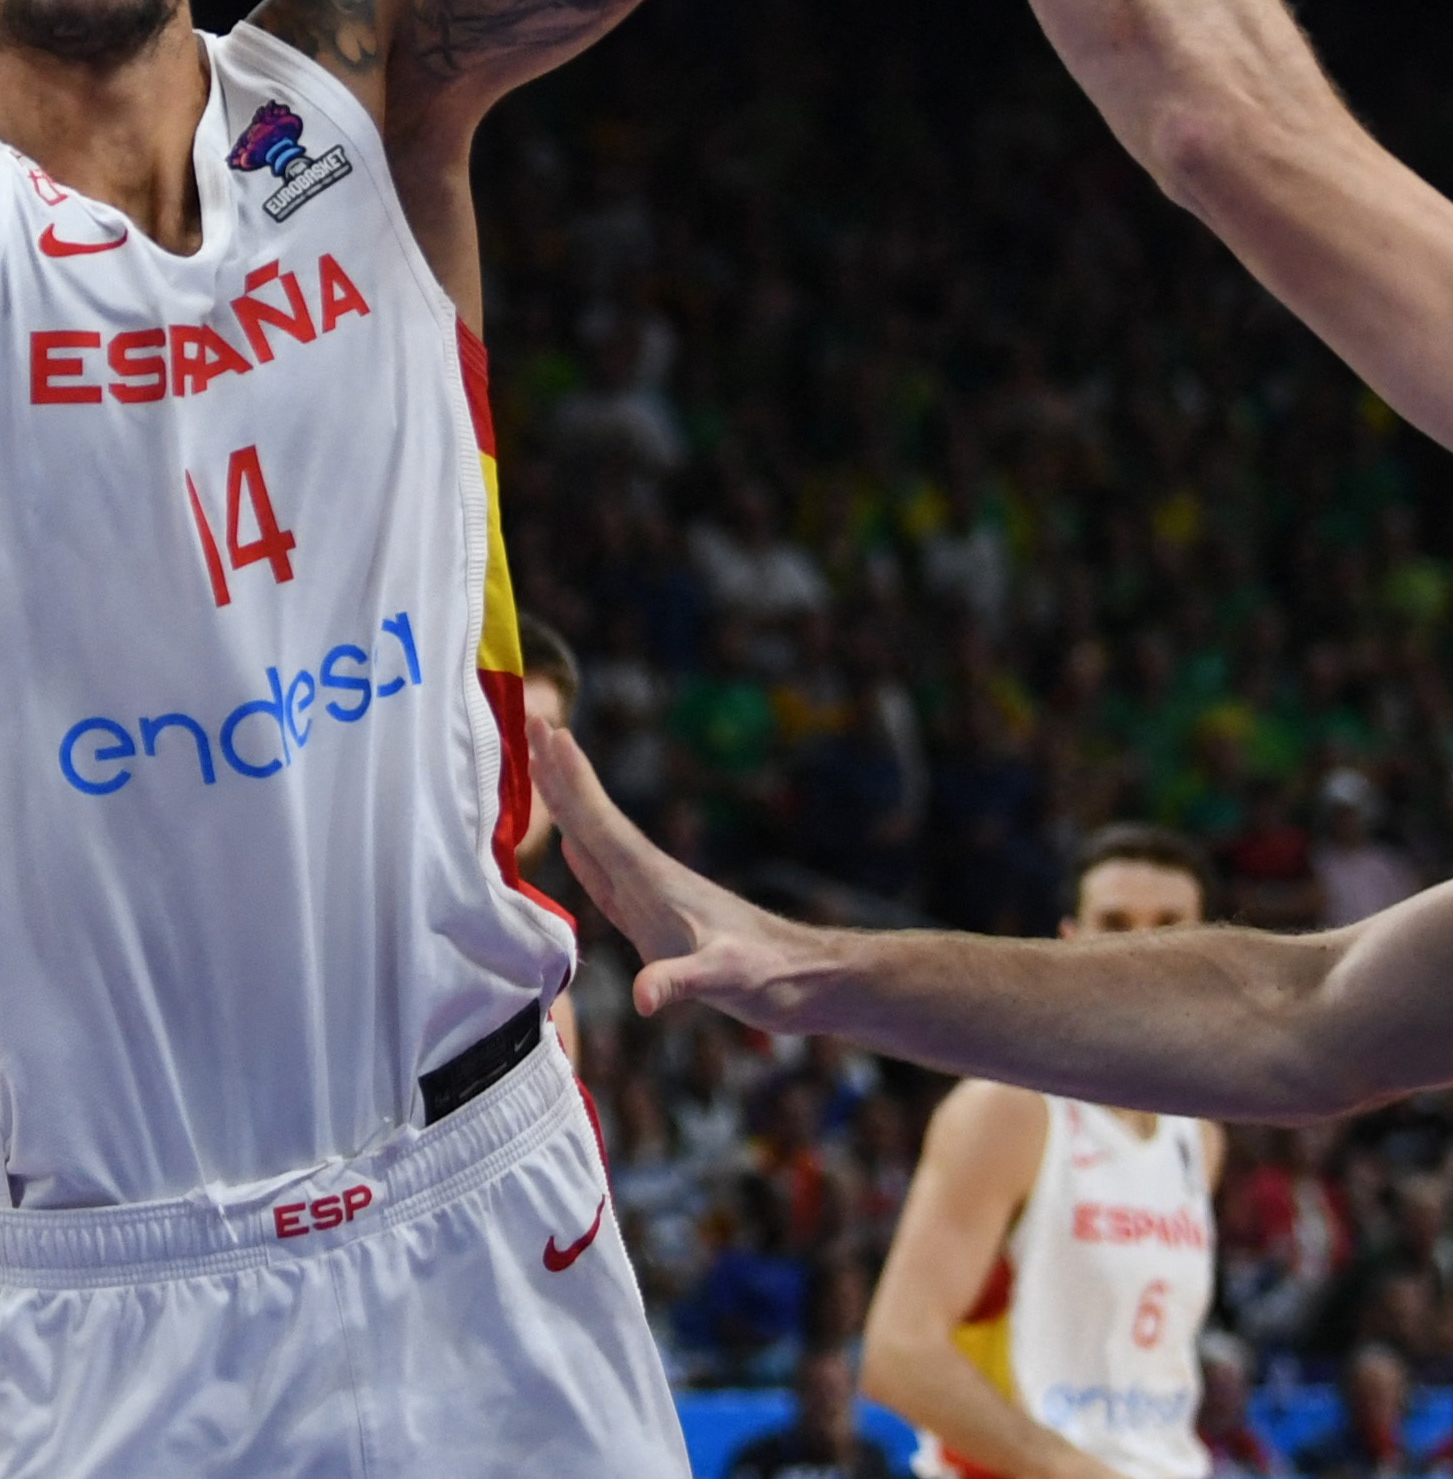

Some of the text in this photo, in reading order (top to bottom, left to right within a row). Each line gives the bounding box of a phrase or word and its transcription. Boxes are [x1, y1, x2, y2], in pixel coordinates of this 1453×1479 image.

[265, 149, 345, 215] EUROBASKET
[30, 253, 371, 405] ESPAÑA
[184, 444, 297, 609] 14
[59, 611, 421, 796] endesa
[273, 1184, 373, 1239] ESP
[1134, 1280, 1170, 1349] 6
